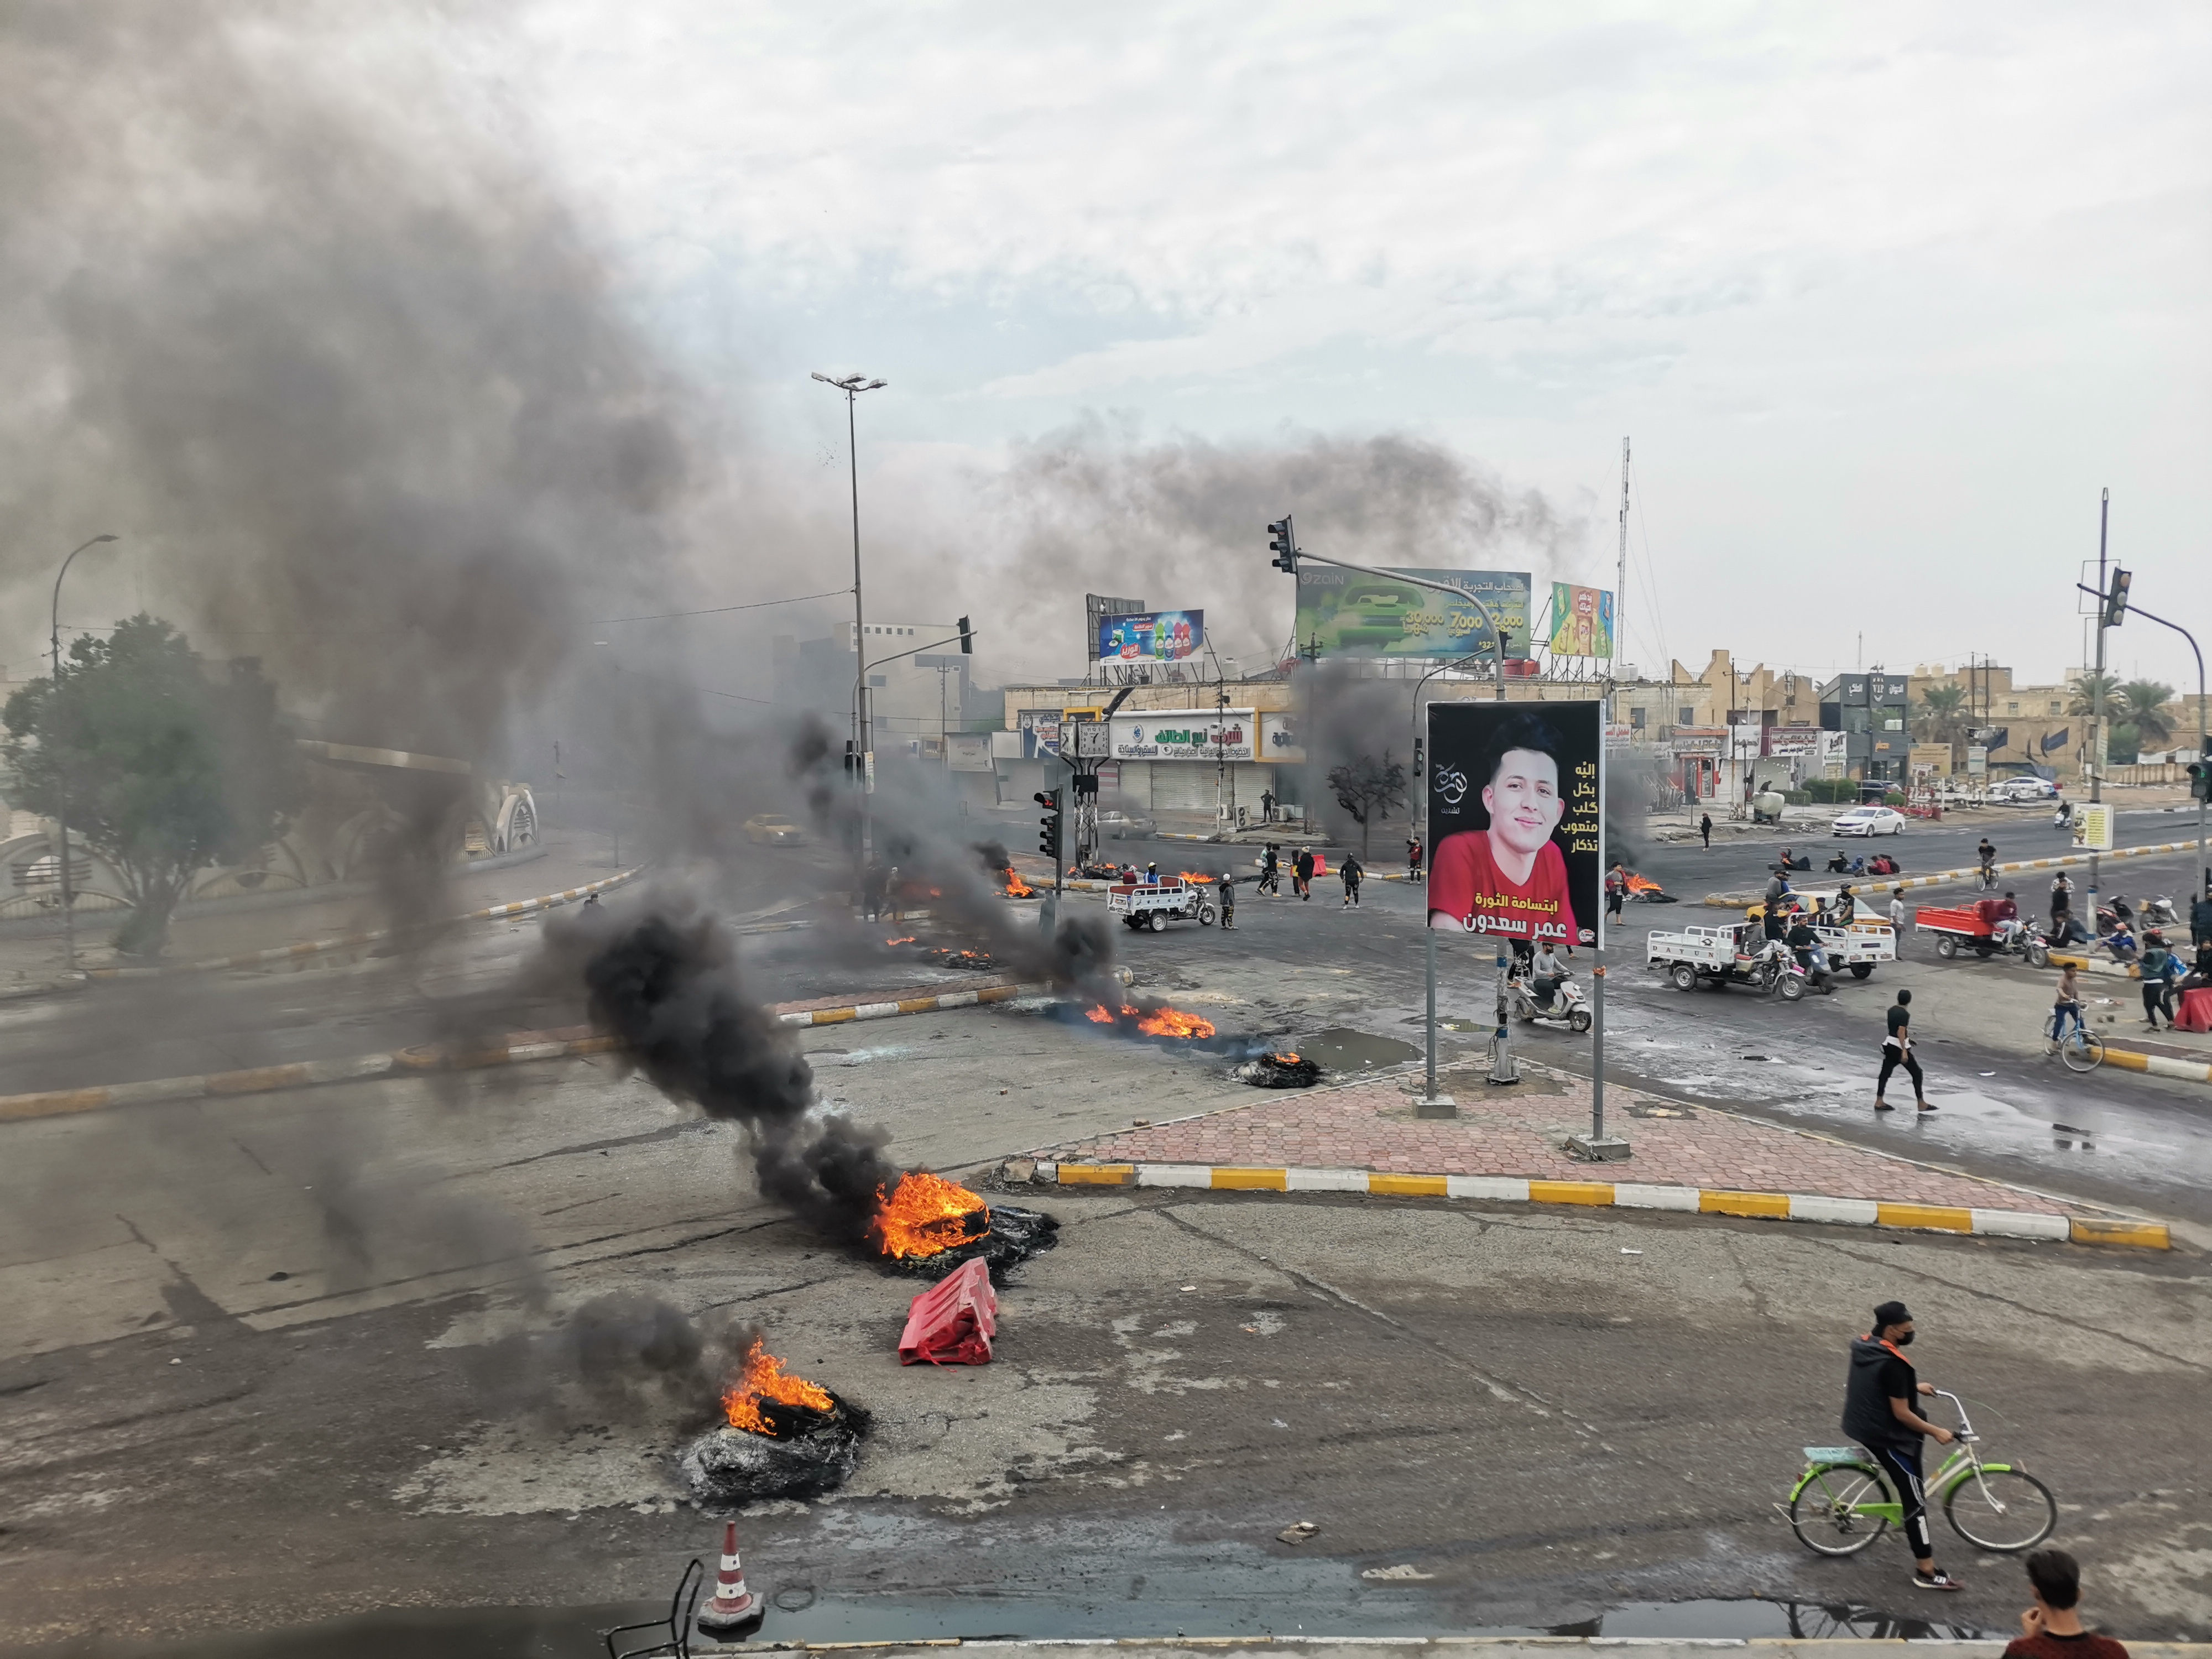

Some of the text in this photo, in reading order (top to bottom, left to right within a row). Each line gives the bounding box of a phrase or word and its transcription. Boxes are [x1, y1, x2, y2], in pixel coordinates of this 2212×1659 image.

[1463, 581, 1493, 593] التجربة
[1122, 643, 1139, 656] الوزير
[1872, 684, 1885, 693] VIP
[1573, 782, 1595, 798] بكل
[1560, 820, 1598, 834] متعوب
[1571, 838, 1598, 853] تذكار
[1475, 892, 1558, 915] ابتسامة الثورة
[1463, 912, 1527, 934] سعدون
[1531, 921, 1567, 940] عمر
[1652, 945, 1714, 958] DAYUN
